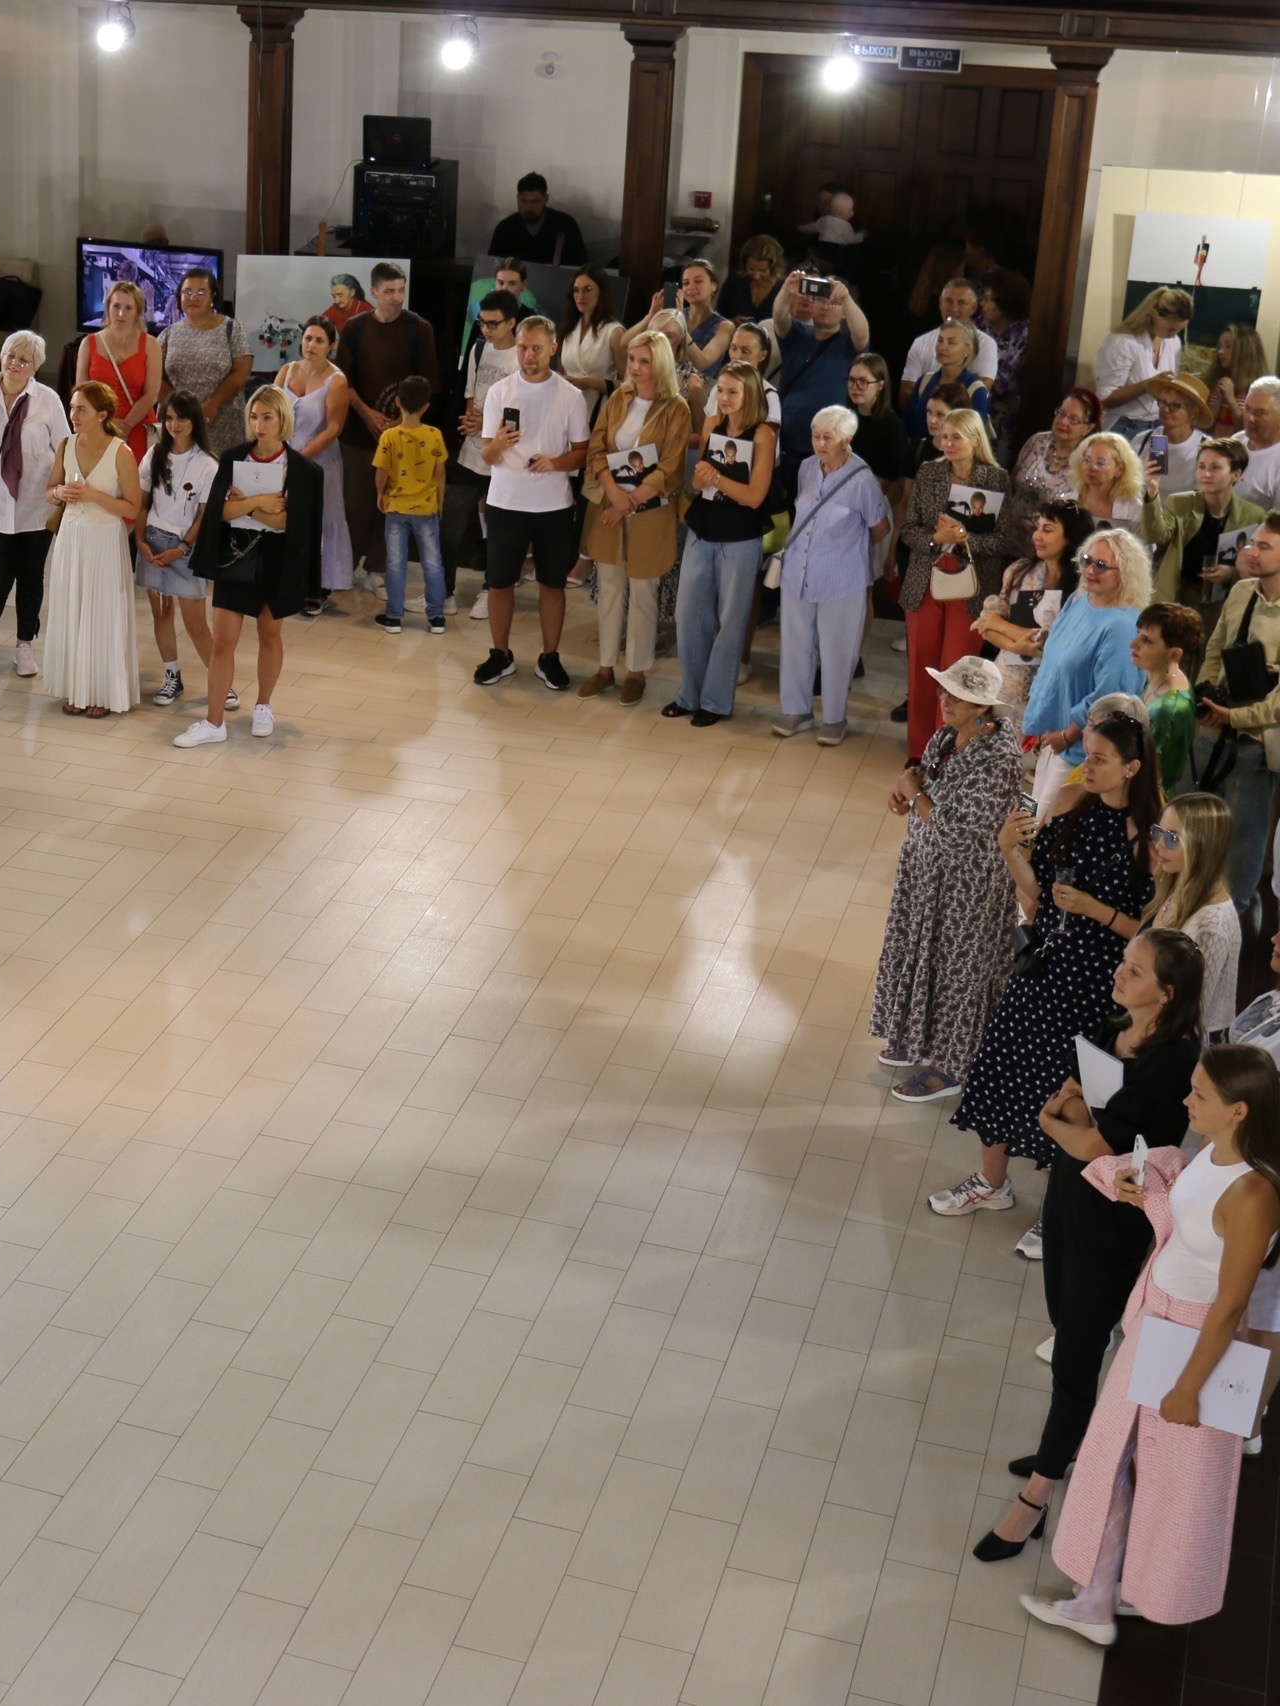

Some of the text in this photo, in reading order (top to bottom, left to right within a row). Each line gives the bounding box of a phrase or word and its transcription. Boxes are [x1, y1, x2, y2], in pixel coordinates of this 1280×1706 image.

[854, 45, 894, 58] ВЫХОД
[909, 48, 953, 61] ВЫХОД
[916, 58, 944, 68] EXIT
